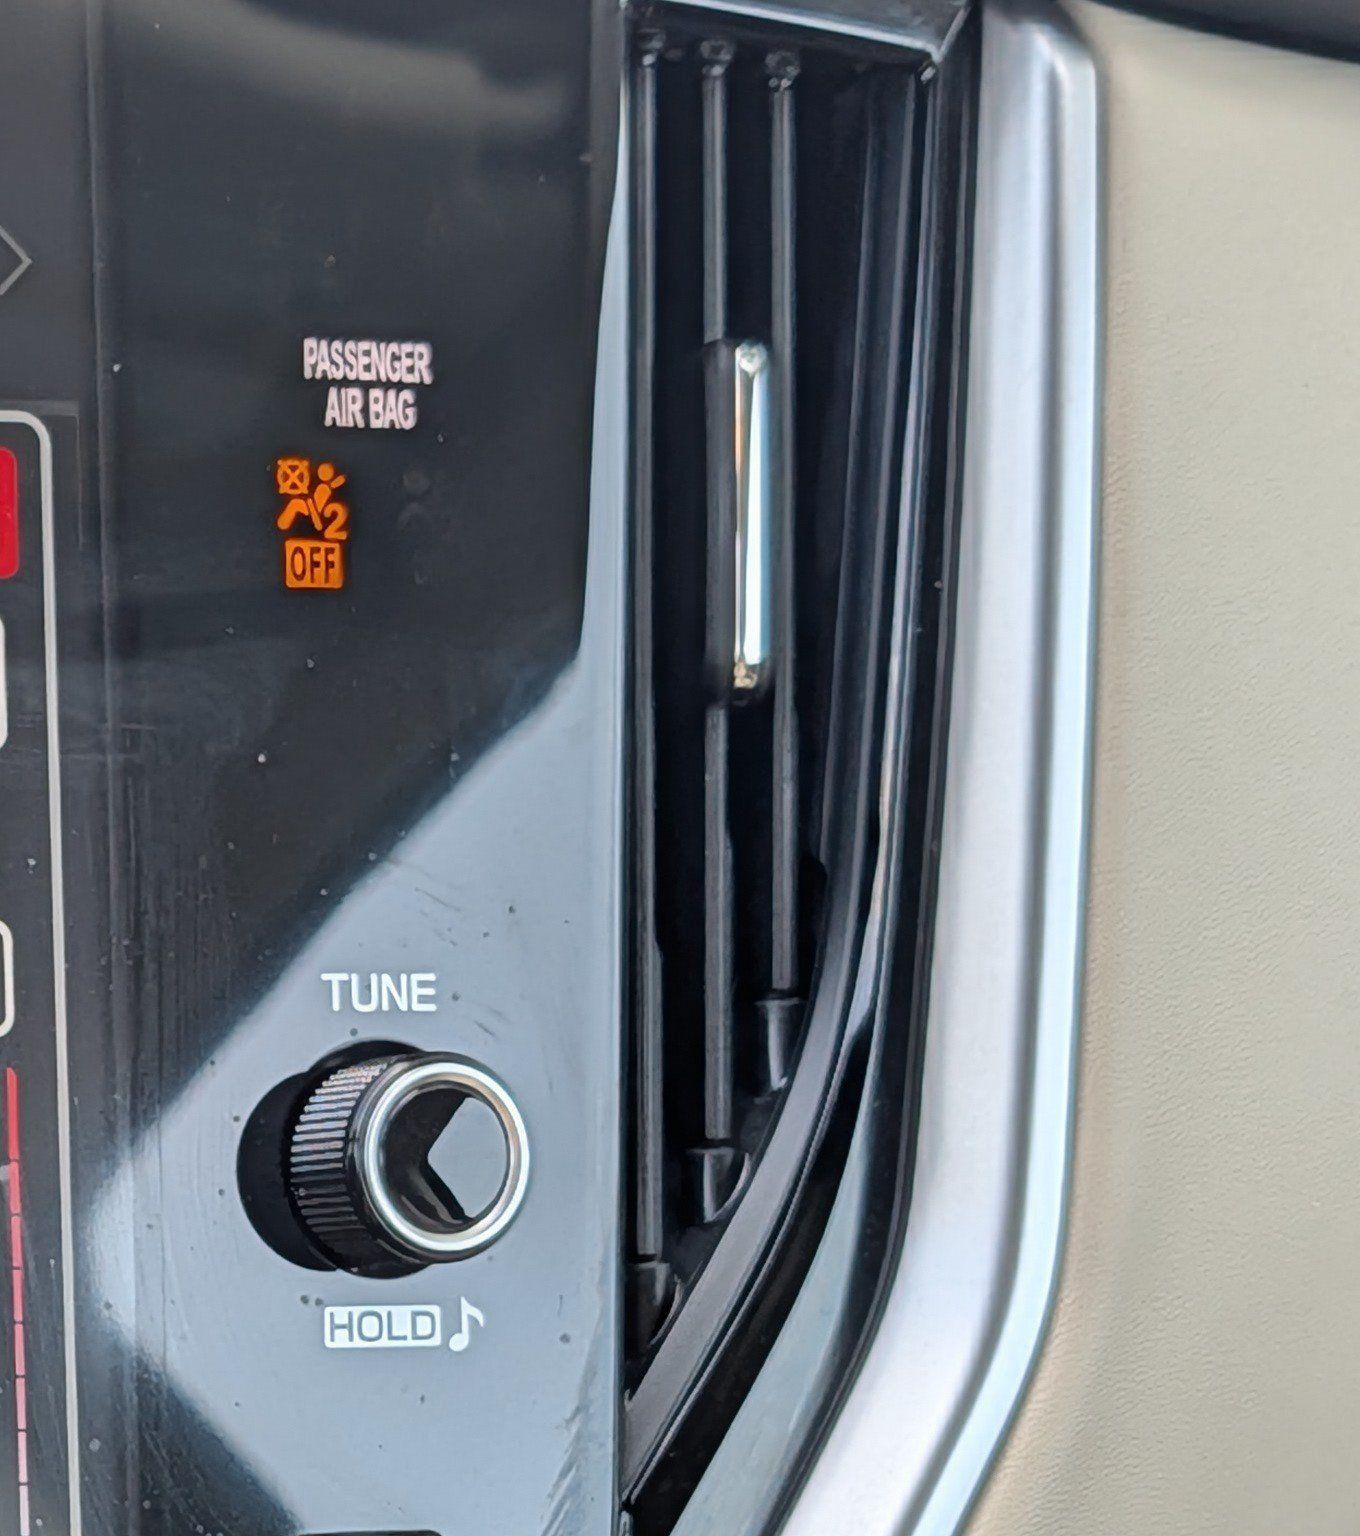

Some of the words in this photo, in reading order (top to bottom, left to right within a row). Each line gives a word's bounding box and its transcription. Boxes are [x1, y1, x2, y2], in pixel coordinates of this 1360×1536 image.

[303, 337, 433, 385] PASSENGER
[324, 386, 365, 429] AIR
[368, 388, 417, 430] BAG
[290, 546, 336, 585] OFF
[320, 972, 438, 1013] TUNE
[329, 1309, 437, 1343] HOLD
